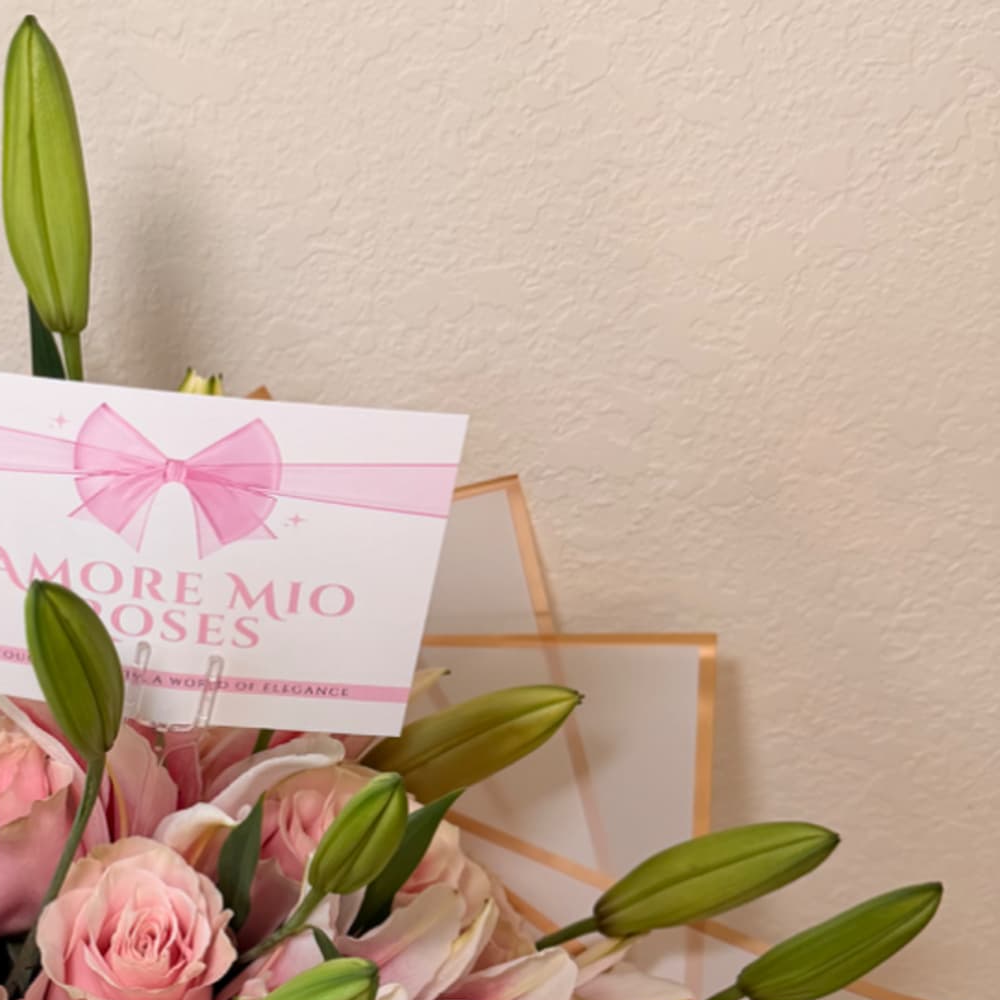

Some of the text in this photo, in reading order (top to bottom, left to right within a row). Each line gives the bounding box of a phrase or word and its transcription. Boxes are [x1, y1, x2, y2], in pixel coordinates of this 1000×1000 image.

[226, 571, 356, 622] MIO
[86, 599, 261, 650] OSES
[235, 681, 255, 691] OF
[263, 682, 350, 698] ELEGANCE
